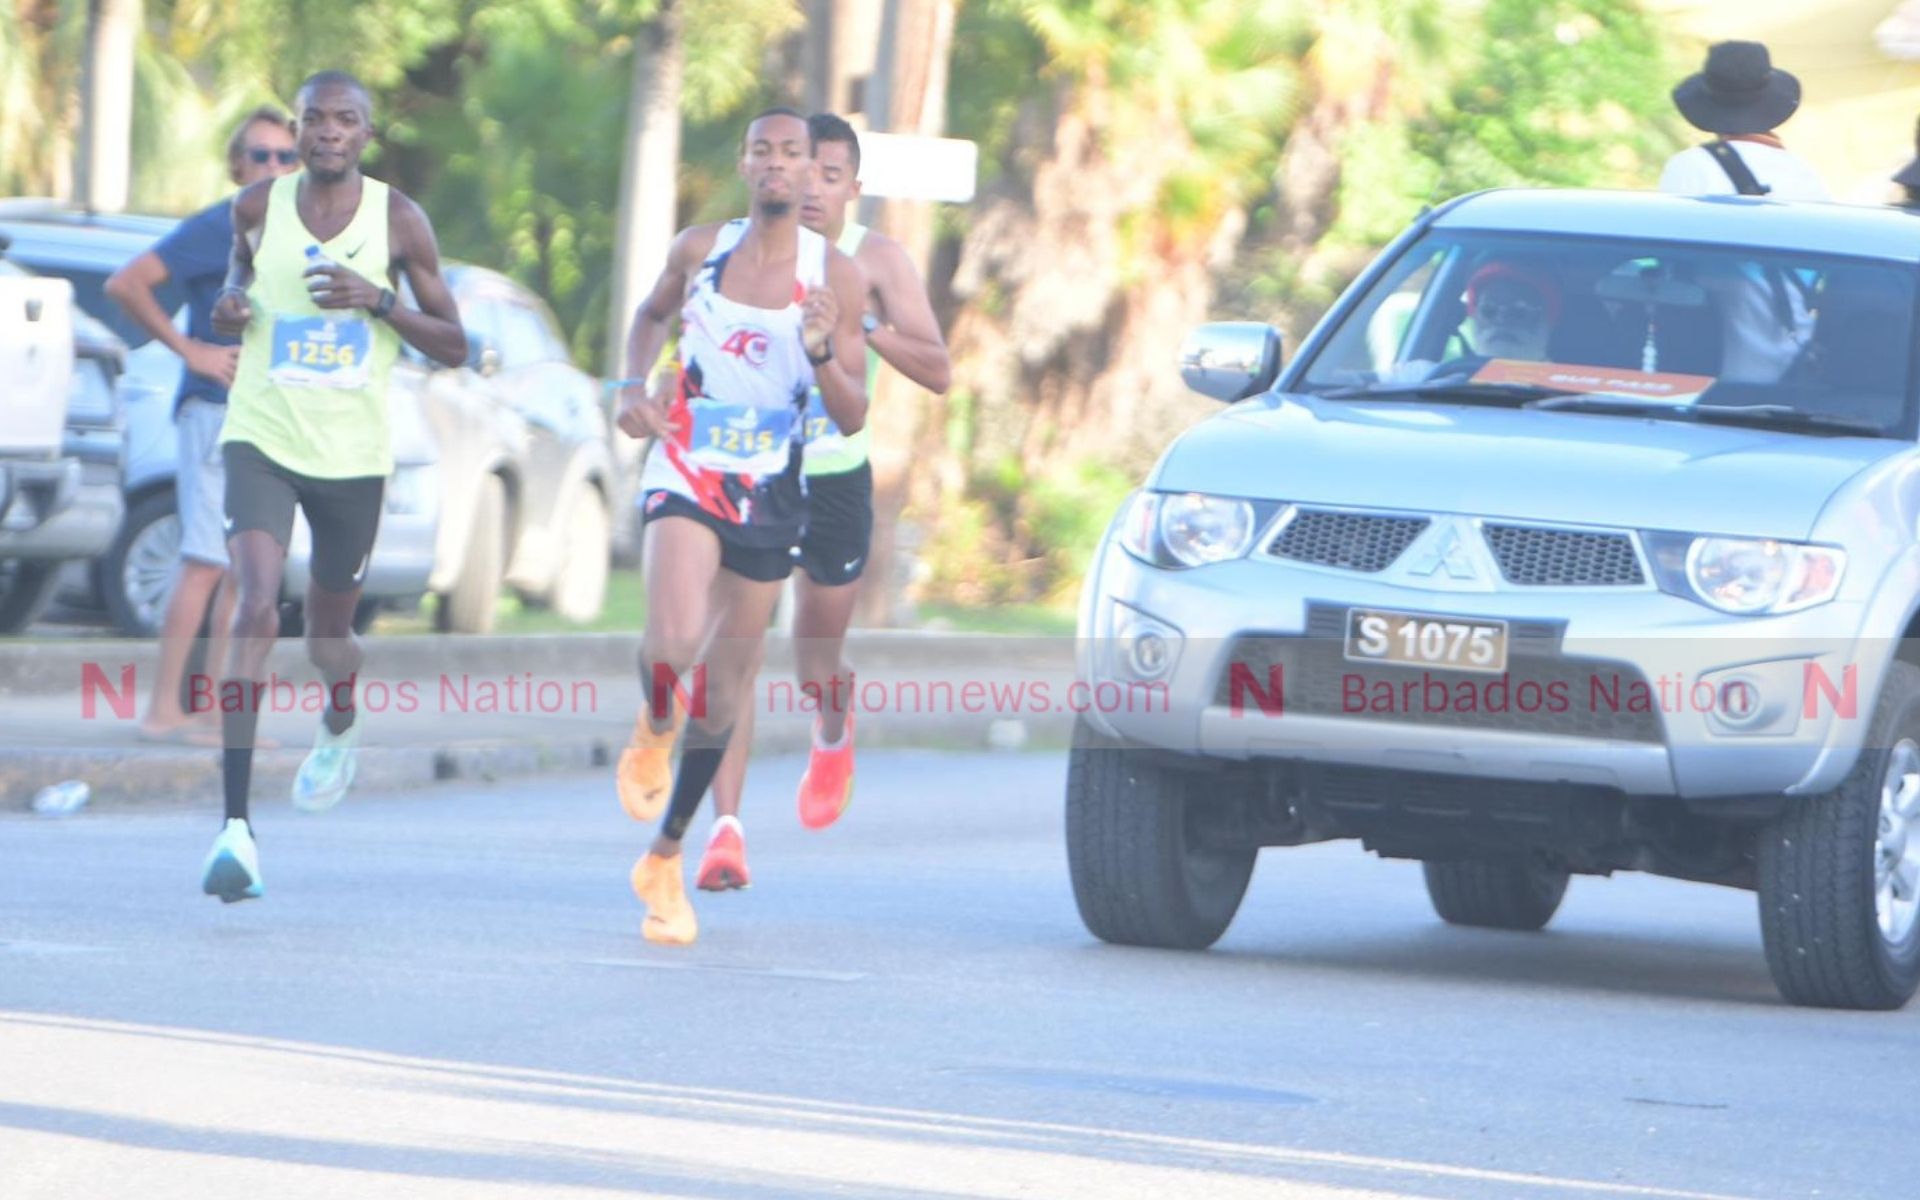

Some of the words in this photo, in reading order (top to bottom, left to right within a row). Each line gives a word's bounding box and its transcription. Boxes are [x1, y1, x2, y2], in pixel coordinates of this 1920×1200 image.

[286, 341, 354, 366] 1256
[710, 426, 773, 451] 1215
[1357, 615, 1388, 657] S
[1398, 620, 1497, 665] 1075
